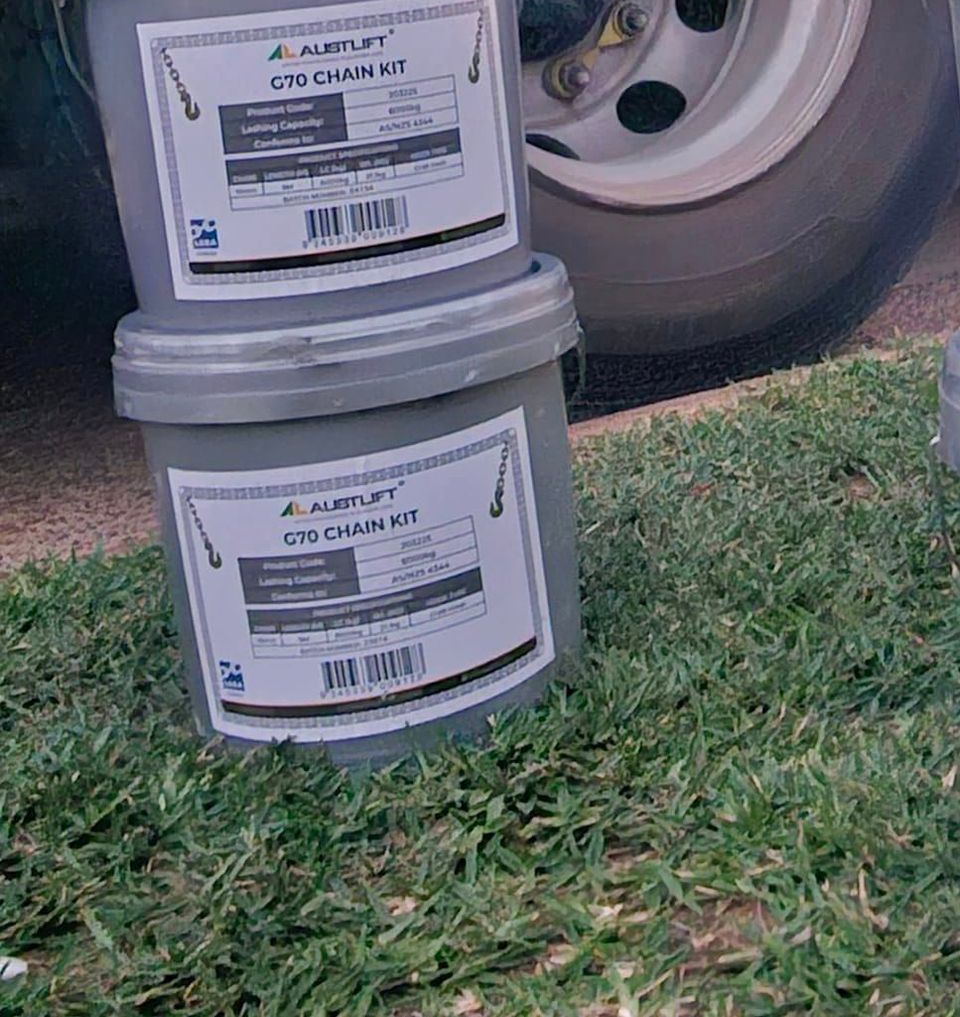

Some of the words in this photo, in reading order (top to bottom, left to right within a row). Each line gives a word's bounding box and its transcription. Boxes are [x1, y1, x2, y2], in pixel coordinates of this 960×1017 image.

[300, 34, 388, 57] AUSTLIFT
[270, 73, 308, 90] G70
[313, 63, 374, 85] CHAIN
[379, 59, 407, 77] KIT
[310, 487, 398, 514] AUSTLIFT
[283, 529, 319, 546] G70
[324, 518, 385, 540] CHAIN
[390, 509, 419, 529] KIT
